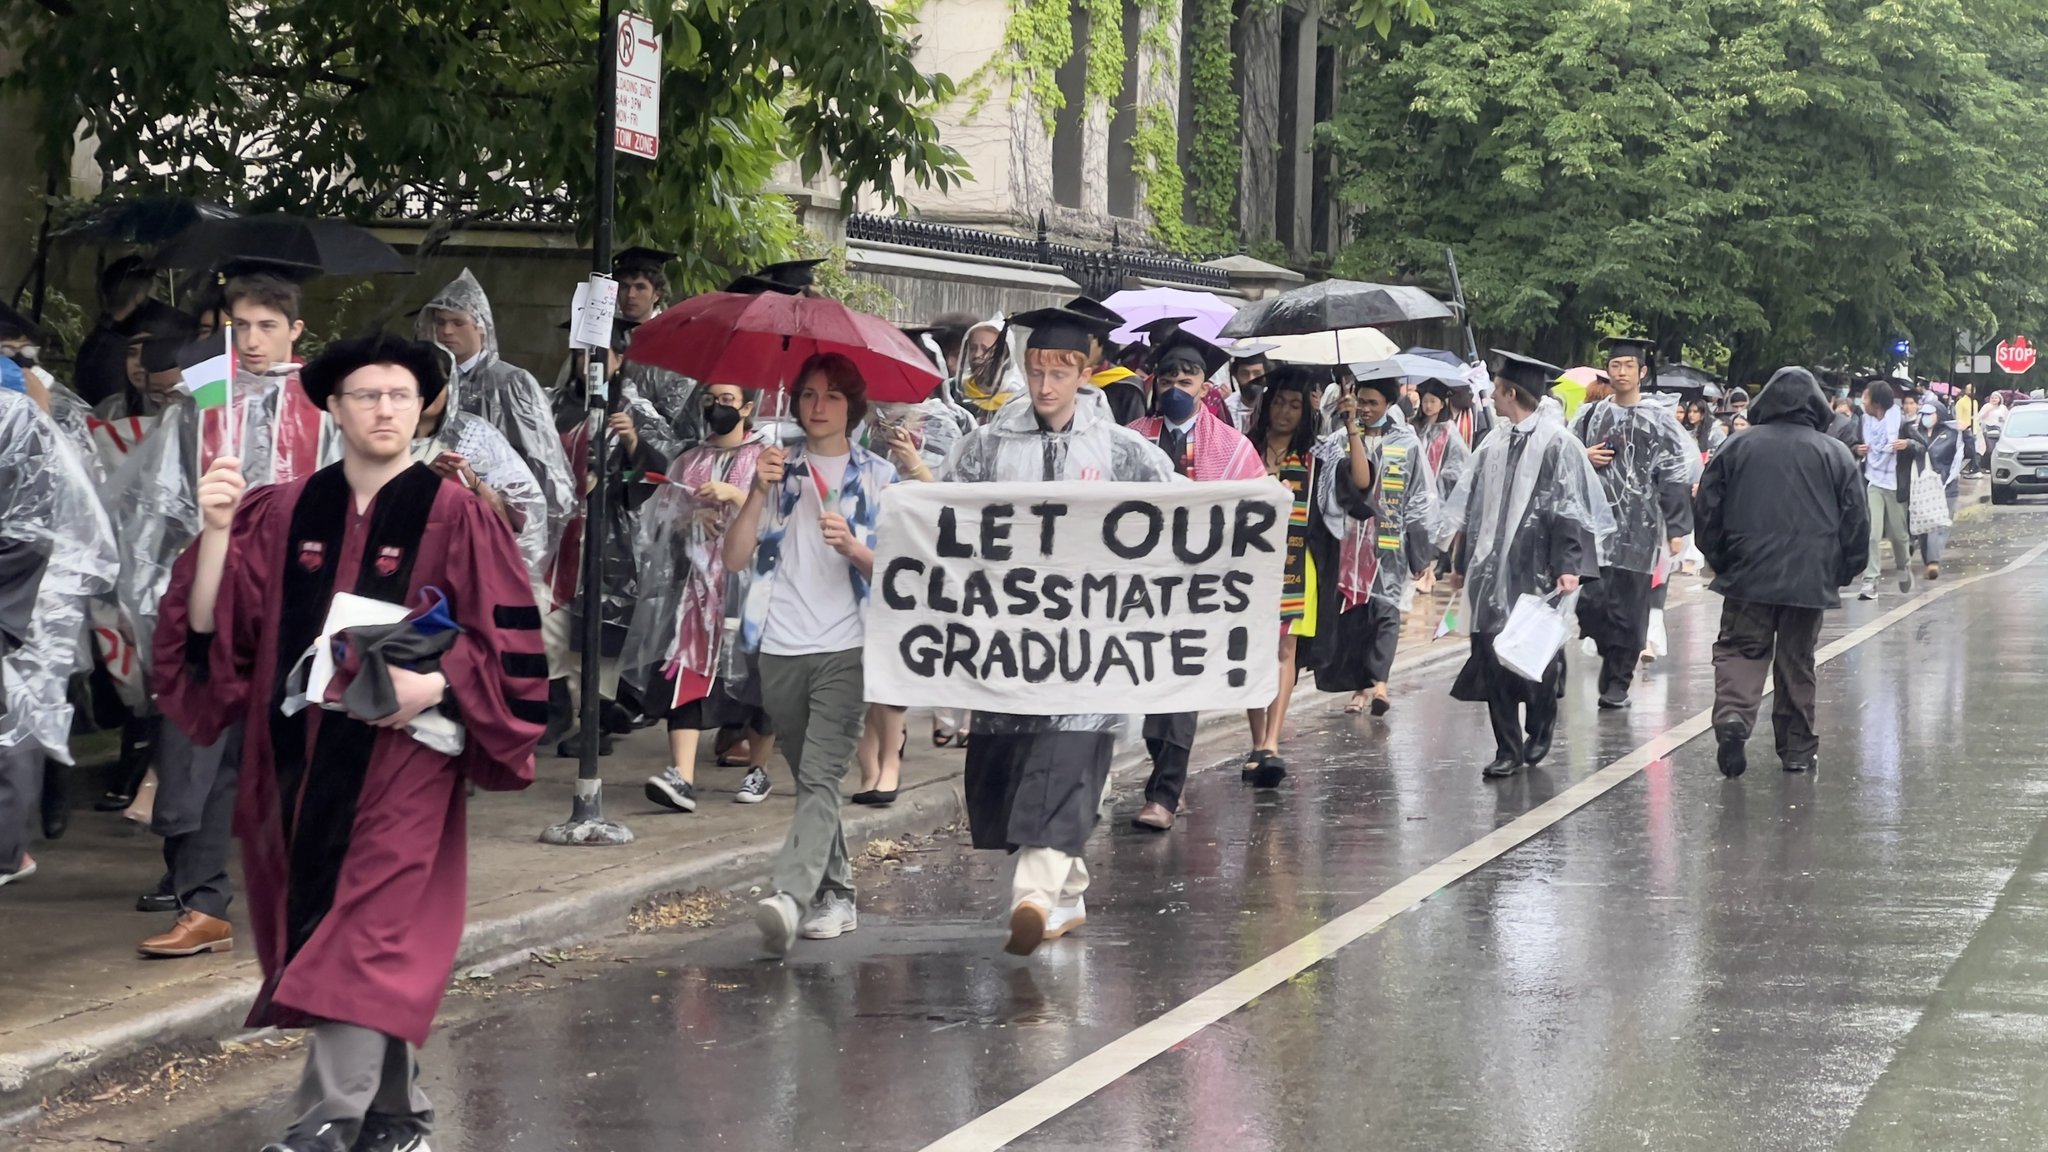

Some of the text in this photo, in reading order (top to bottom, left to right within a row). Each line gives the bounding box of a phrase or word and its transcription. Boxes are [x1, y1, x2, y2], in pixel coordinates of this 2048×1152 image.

[640, 84, 652, 98] ZONE
[615, 129, 654, 154] TOW ZONE
[1999, 347, 2033, 362] STOP
[936, 499, 1277, 565] LET OUR
[882, 556, 1254, 622] CLASSMATES
